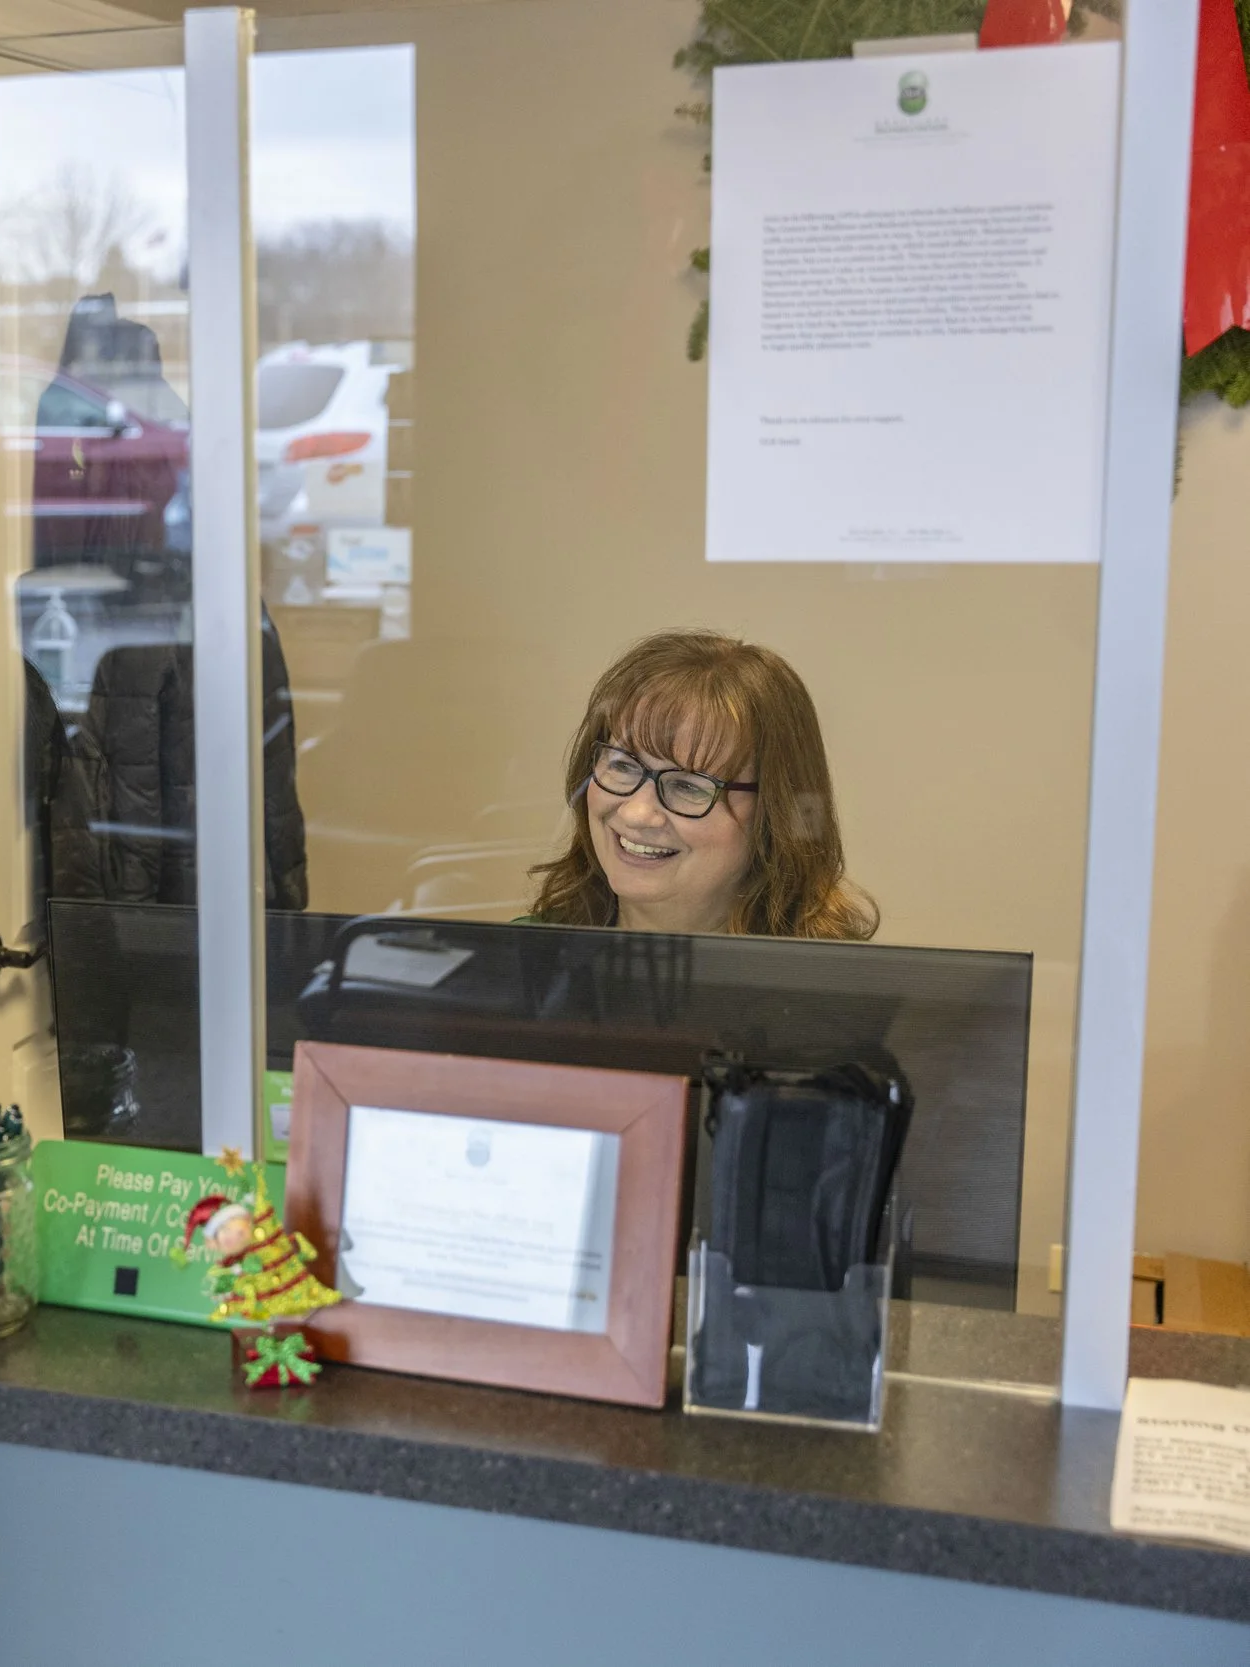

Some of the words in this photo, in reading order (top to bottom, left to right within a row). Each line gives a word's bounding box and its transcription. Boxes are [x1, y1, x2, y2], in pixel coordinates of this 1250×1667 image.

[96, 1164, 154, 1193] Please
[158, 1171, 193, 1202] Pay
[44, 1188, 148, 1223] Co-Payment
[75, 1224, 97, 1248] At
[101, 1226, 144, 1254] Time
[147, 1232, 170, 1257] Of
